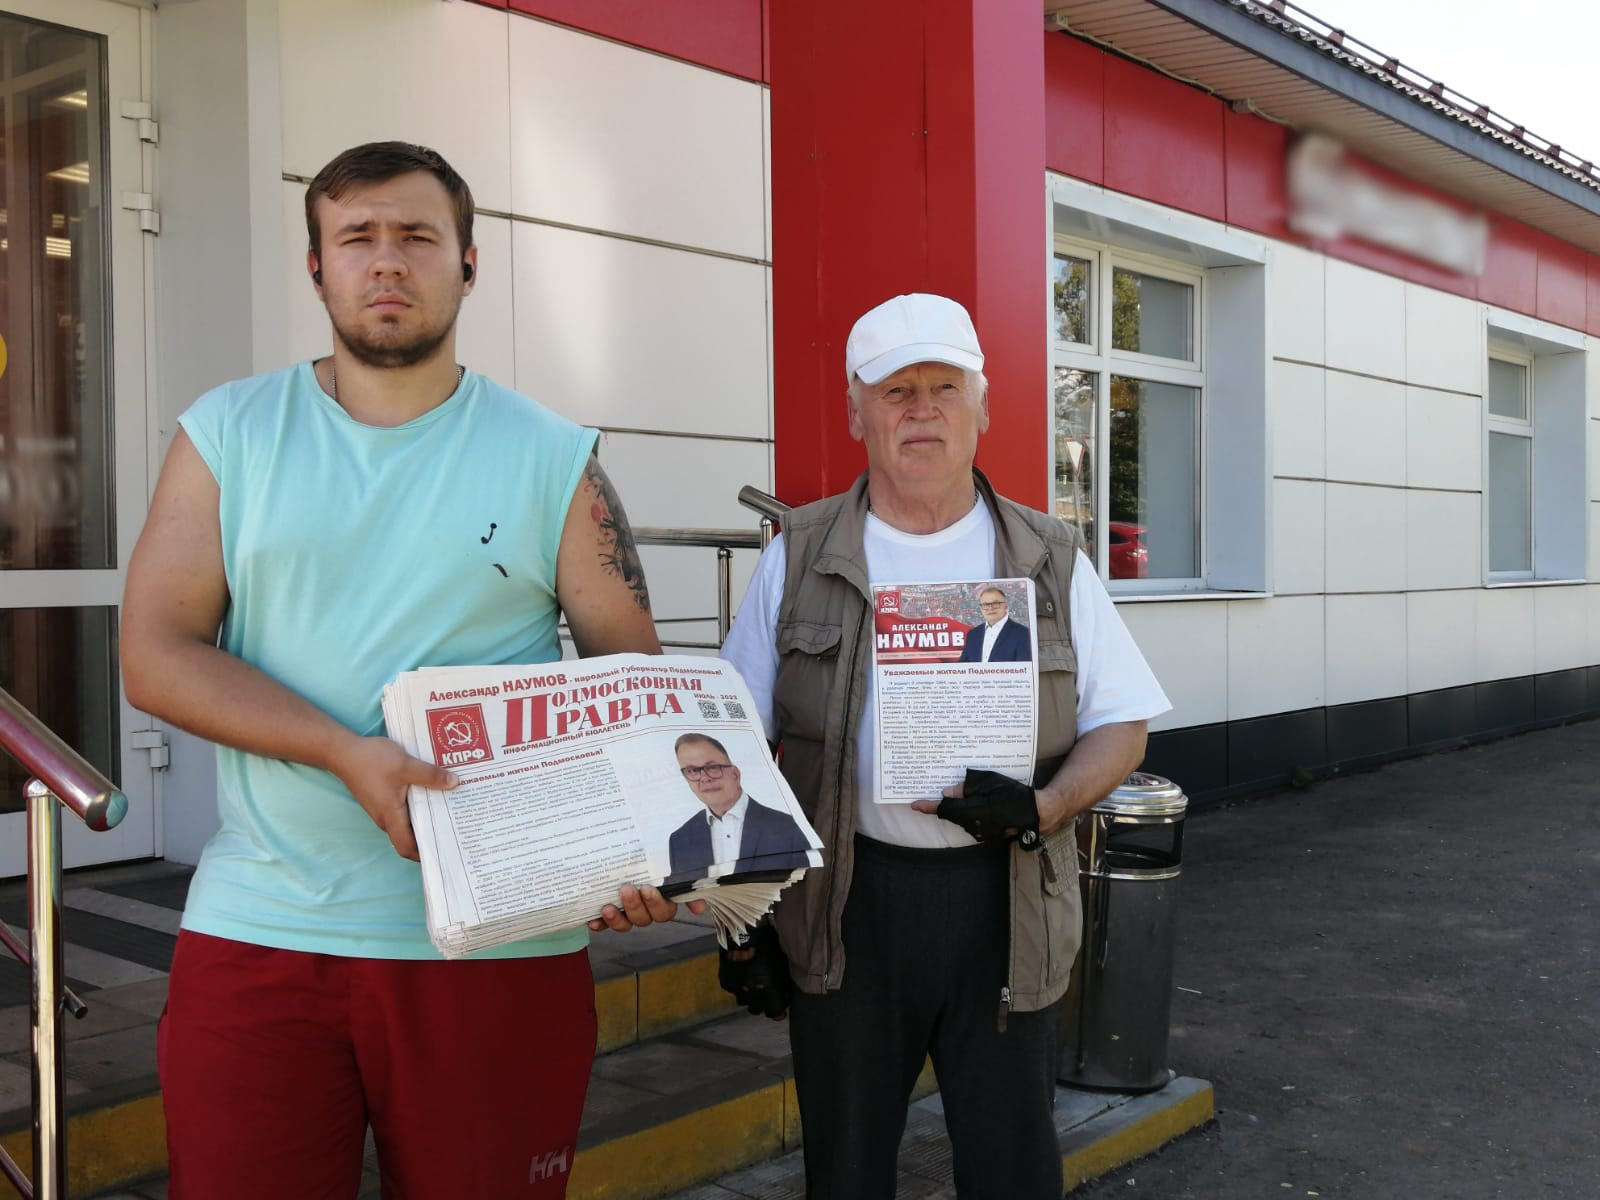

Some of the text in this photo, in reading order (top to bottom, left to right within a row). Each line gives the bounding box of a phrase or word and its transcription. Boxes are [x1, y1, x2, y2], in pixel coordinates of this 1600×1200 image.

[891, 623, 949, 632] АЛЕКСАНДР
[877, 631, 965, 649] НАУМОВ
[883, 669, 935, 677] Уважаемые
[969, 667, 1028, 676] Подмосковья!
[429, 684, 500, 702] Александр
[502, 674, 567, 693] НАУМОВ
[574, 669, 620, 683] народный
[503, 722, 631, 755] ИНФОРМАЦИОННЫЙ БЮЛЛЕТЕНЬ
[441, 748, 486, 765] КПРФ
[507, 764, 540, 776] жители
[541, 748, 604, 768] Подмосковья!
[529, 1145, 571, 1185] HH
